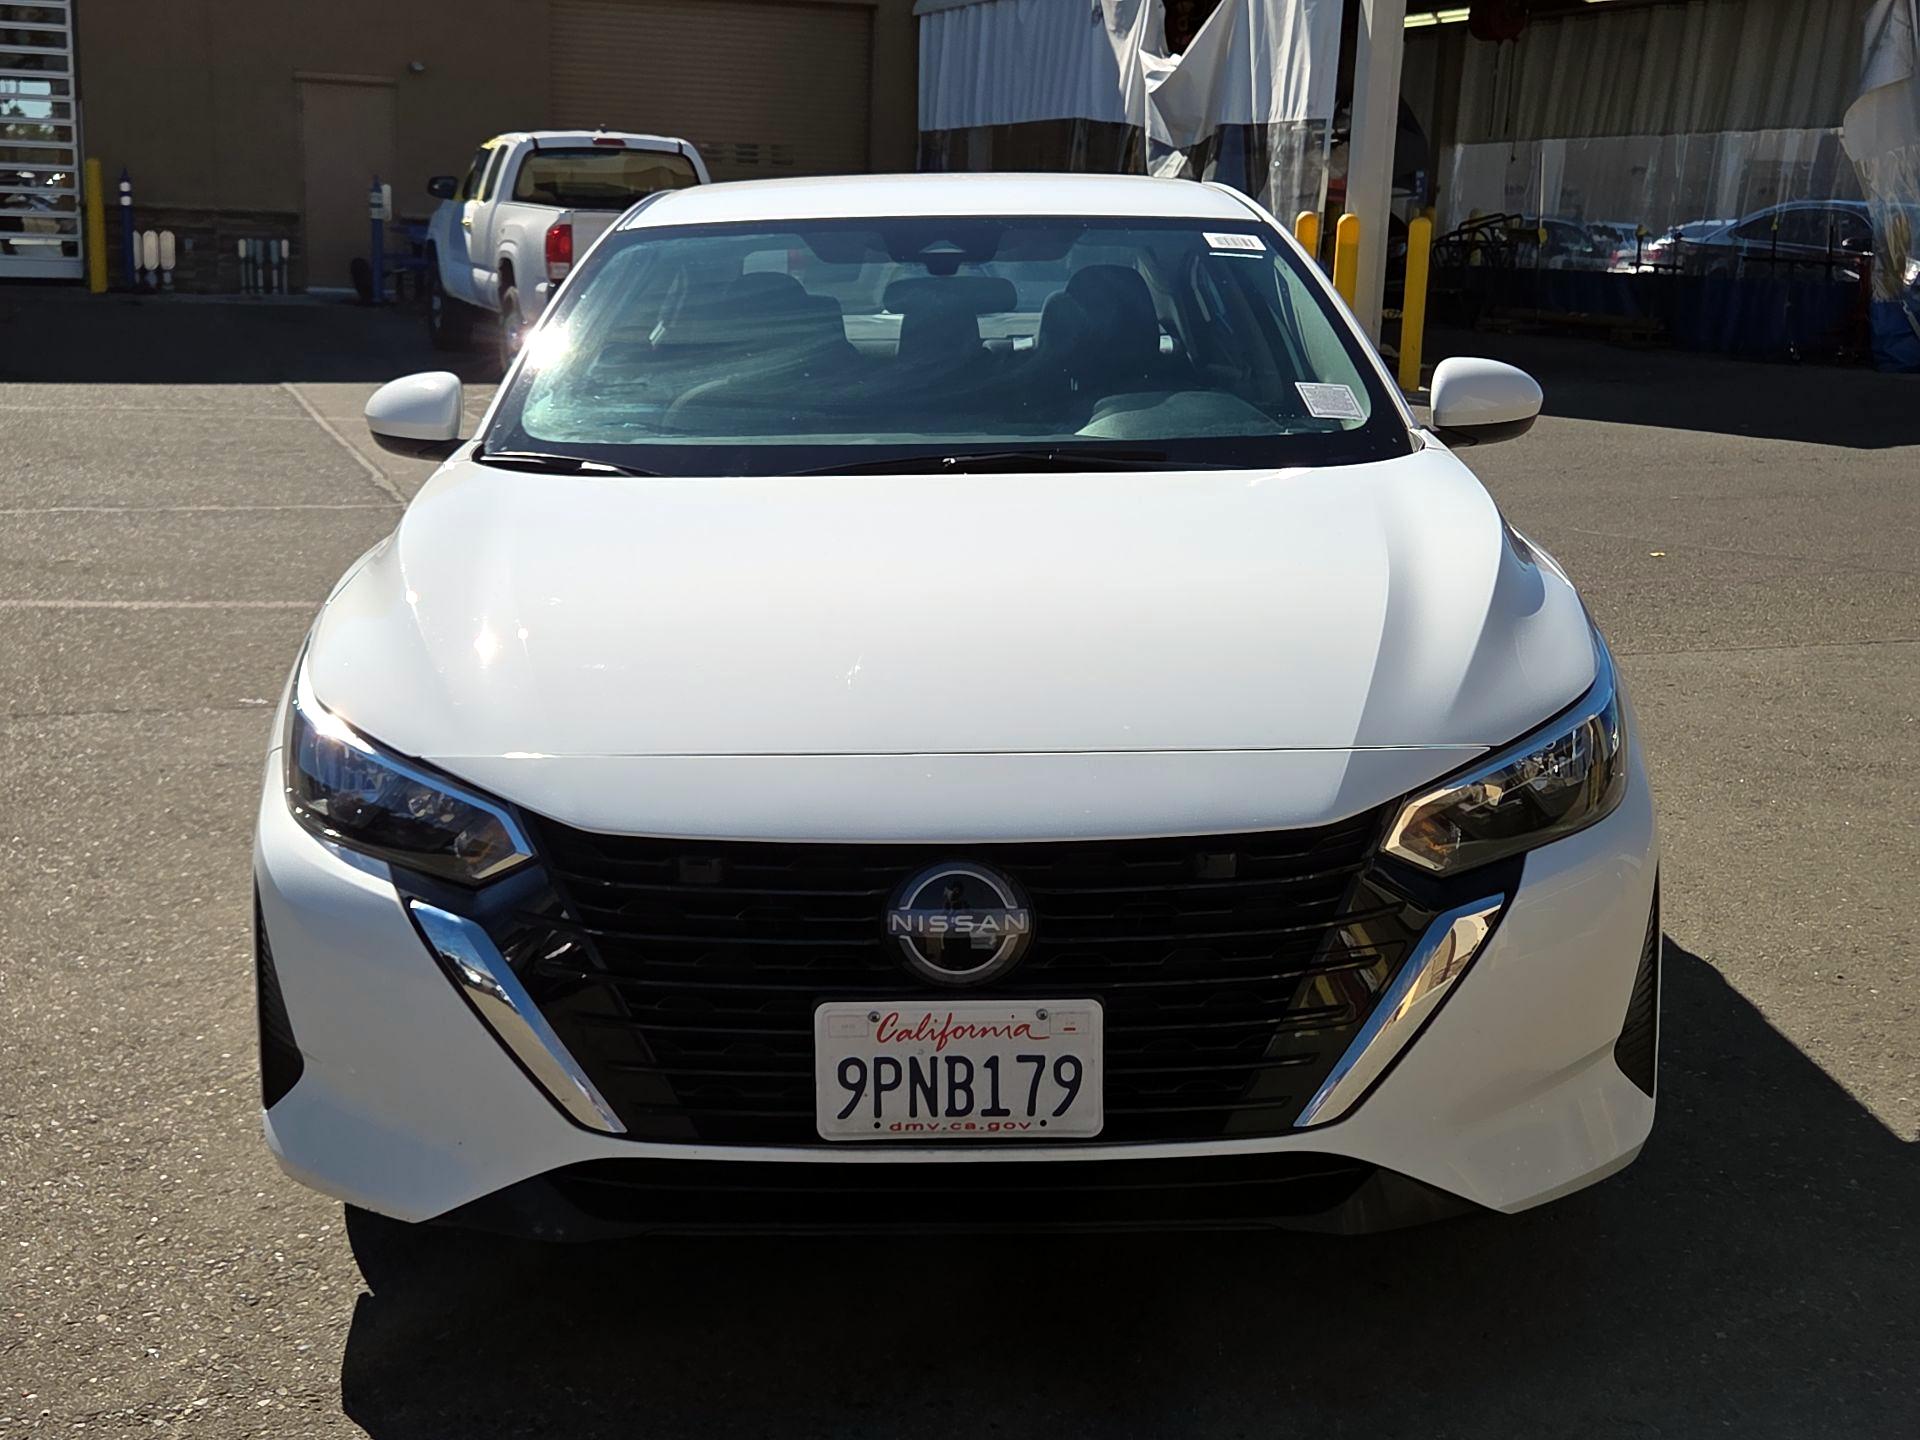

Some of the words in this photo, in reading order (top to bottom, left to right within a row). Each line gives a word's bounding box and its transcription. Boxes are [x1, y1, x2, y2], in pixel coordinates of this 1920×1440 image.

[891, 913, 1026, 933] NISSAN
[876, 1012, 1050, 1051] California
[837, 1054, 1083, 1119] 9PNB179
[889, 1120, 1032, 1132] dmv.ca.gov
